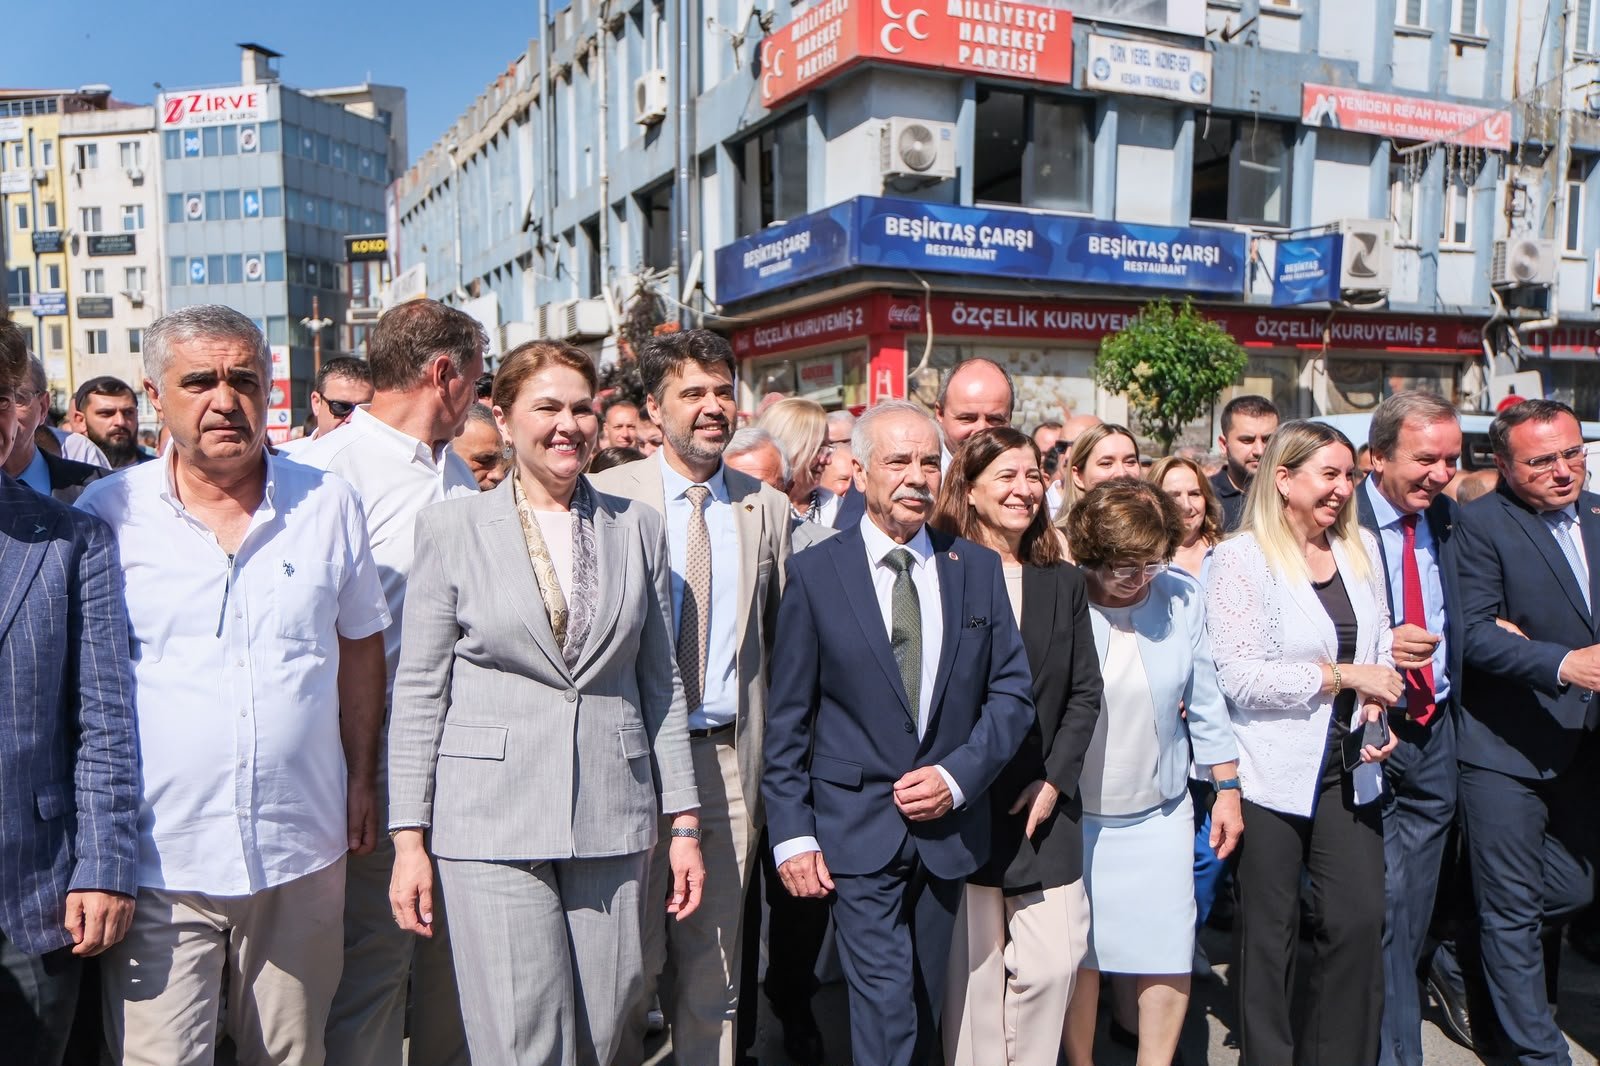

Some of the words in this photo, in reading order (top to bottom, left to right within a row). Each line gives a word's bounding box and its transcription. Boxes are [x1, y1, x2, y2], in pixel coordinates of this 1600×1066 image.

[797, 19, 841, 60] HAREKET
[960, 22, 1046, 53] HAREKET
[797, 41, 837, 81] PARTİSİ
[959, 44, 1036, 73] PARTİSİ
[1338, 95, 1390, 115] YENİDEN
[1393, 103, 1432, 121] REFAH
[885, 215, 976, 246] BEŞİKTAŞ
[980, 226, 1033, 252] ÇARŞI
[743, 240, 783, 269] BEŞİKTAŞ
[783, 230, 810, 258] ÇARŞI
[925, 243, 997, 261] RESTAURANT
[1088, 234, 1169, 262] BEŞİKTAŞ
[1172, 243, 1220, 267] ÇARŞI
[1124, 260, 1187, 276] RESTAURANT
[754, 320, 793, 348] ÖZÇELİK
[793, 306, 853, 338] KURUYEMİŞ
[855, 307, 863, 326] 2
[951, 301, 1038, 330] ÖZÇELİK
[1255, 316, 1324, 342] ÖZÇELİK
[1331, 321, 1423, 344] KURUYEMİŞ
[1427, 327, 1437, 342] 2
